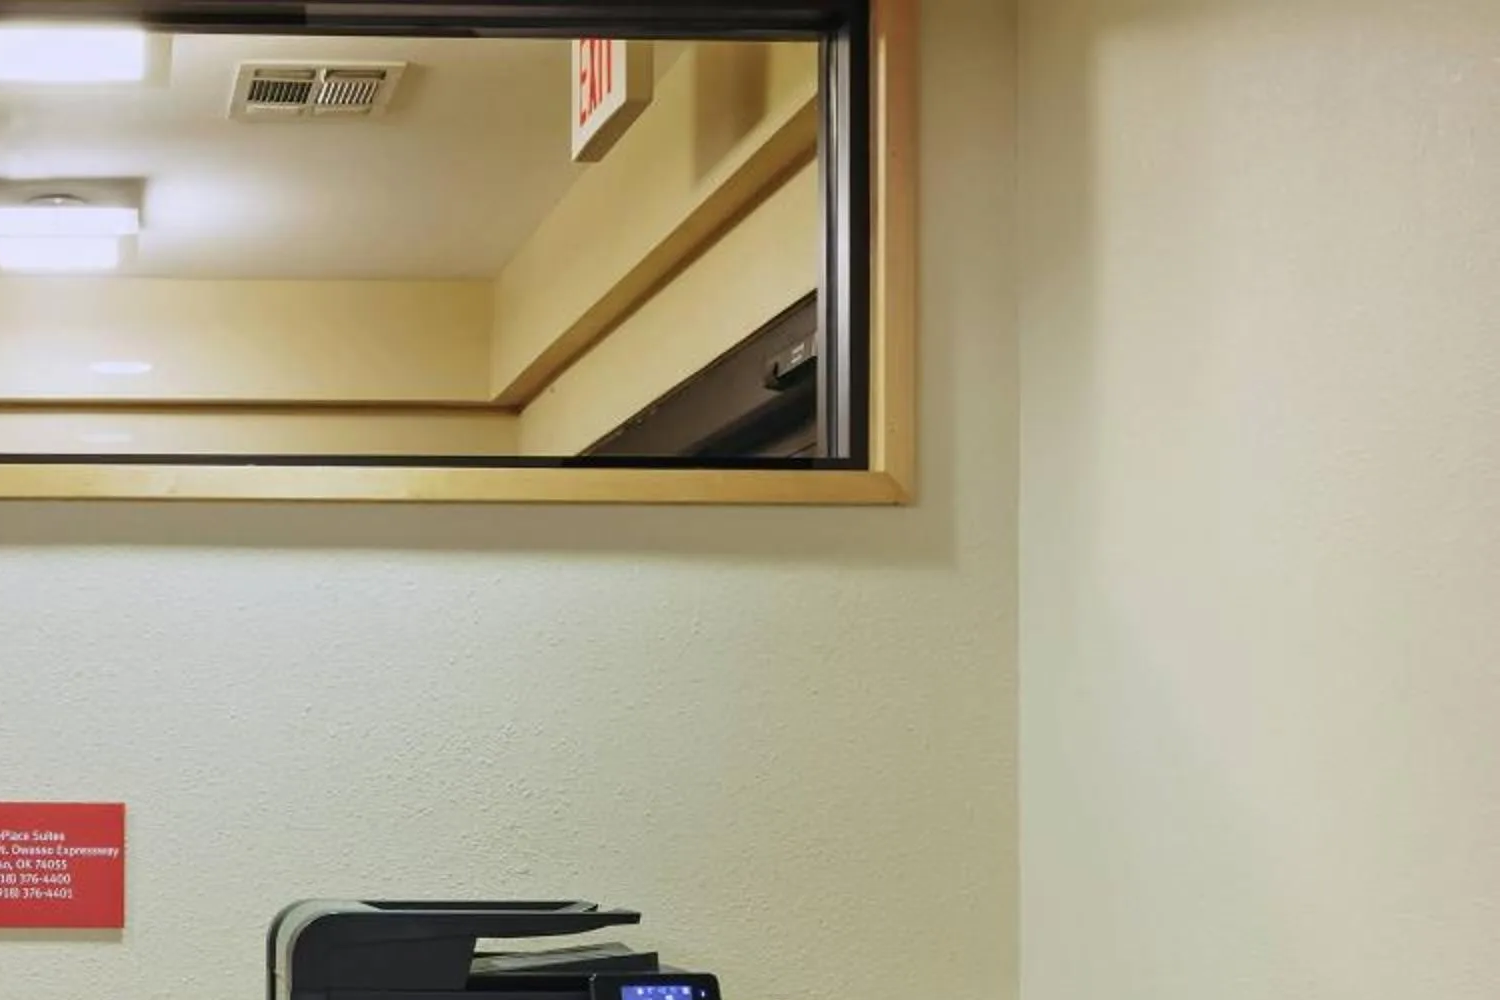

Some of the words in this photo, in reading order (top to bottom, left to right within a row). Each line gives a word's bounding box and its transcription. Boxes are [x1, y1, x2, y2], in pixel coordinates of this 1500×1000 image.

[32, 829, 66, 842] Suites
[11, 844, 54, 856] Owasso
[56, 844, 120, 859] Expressway
[15, 859, 33, 869] OK
